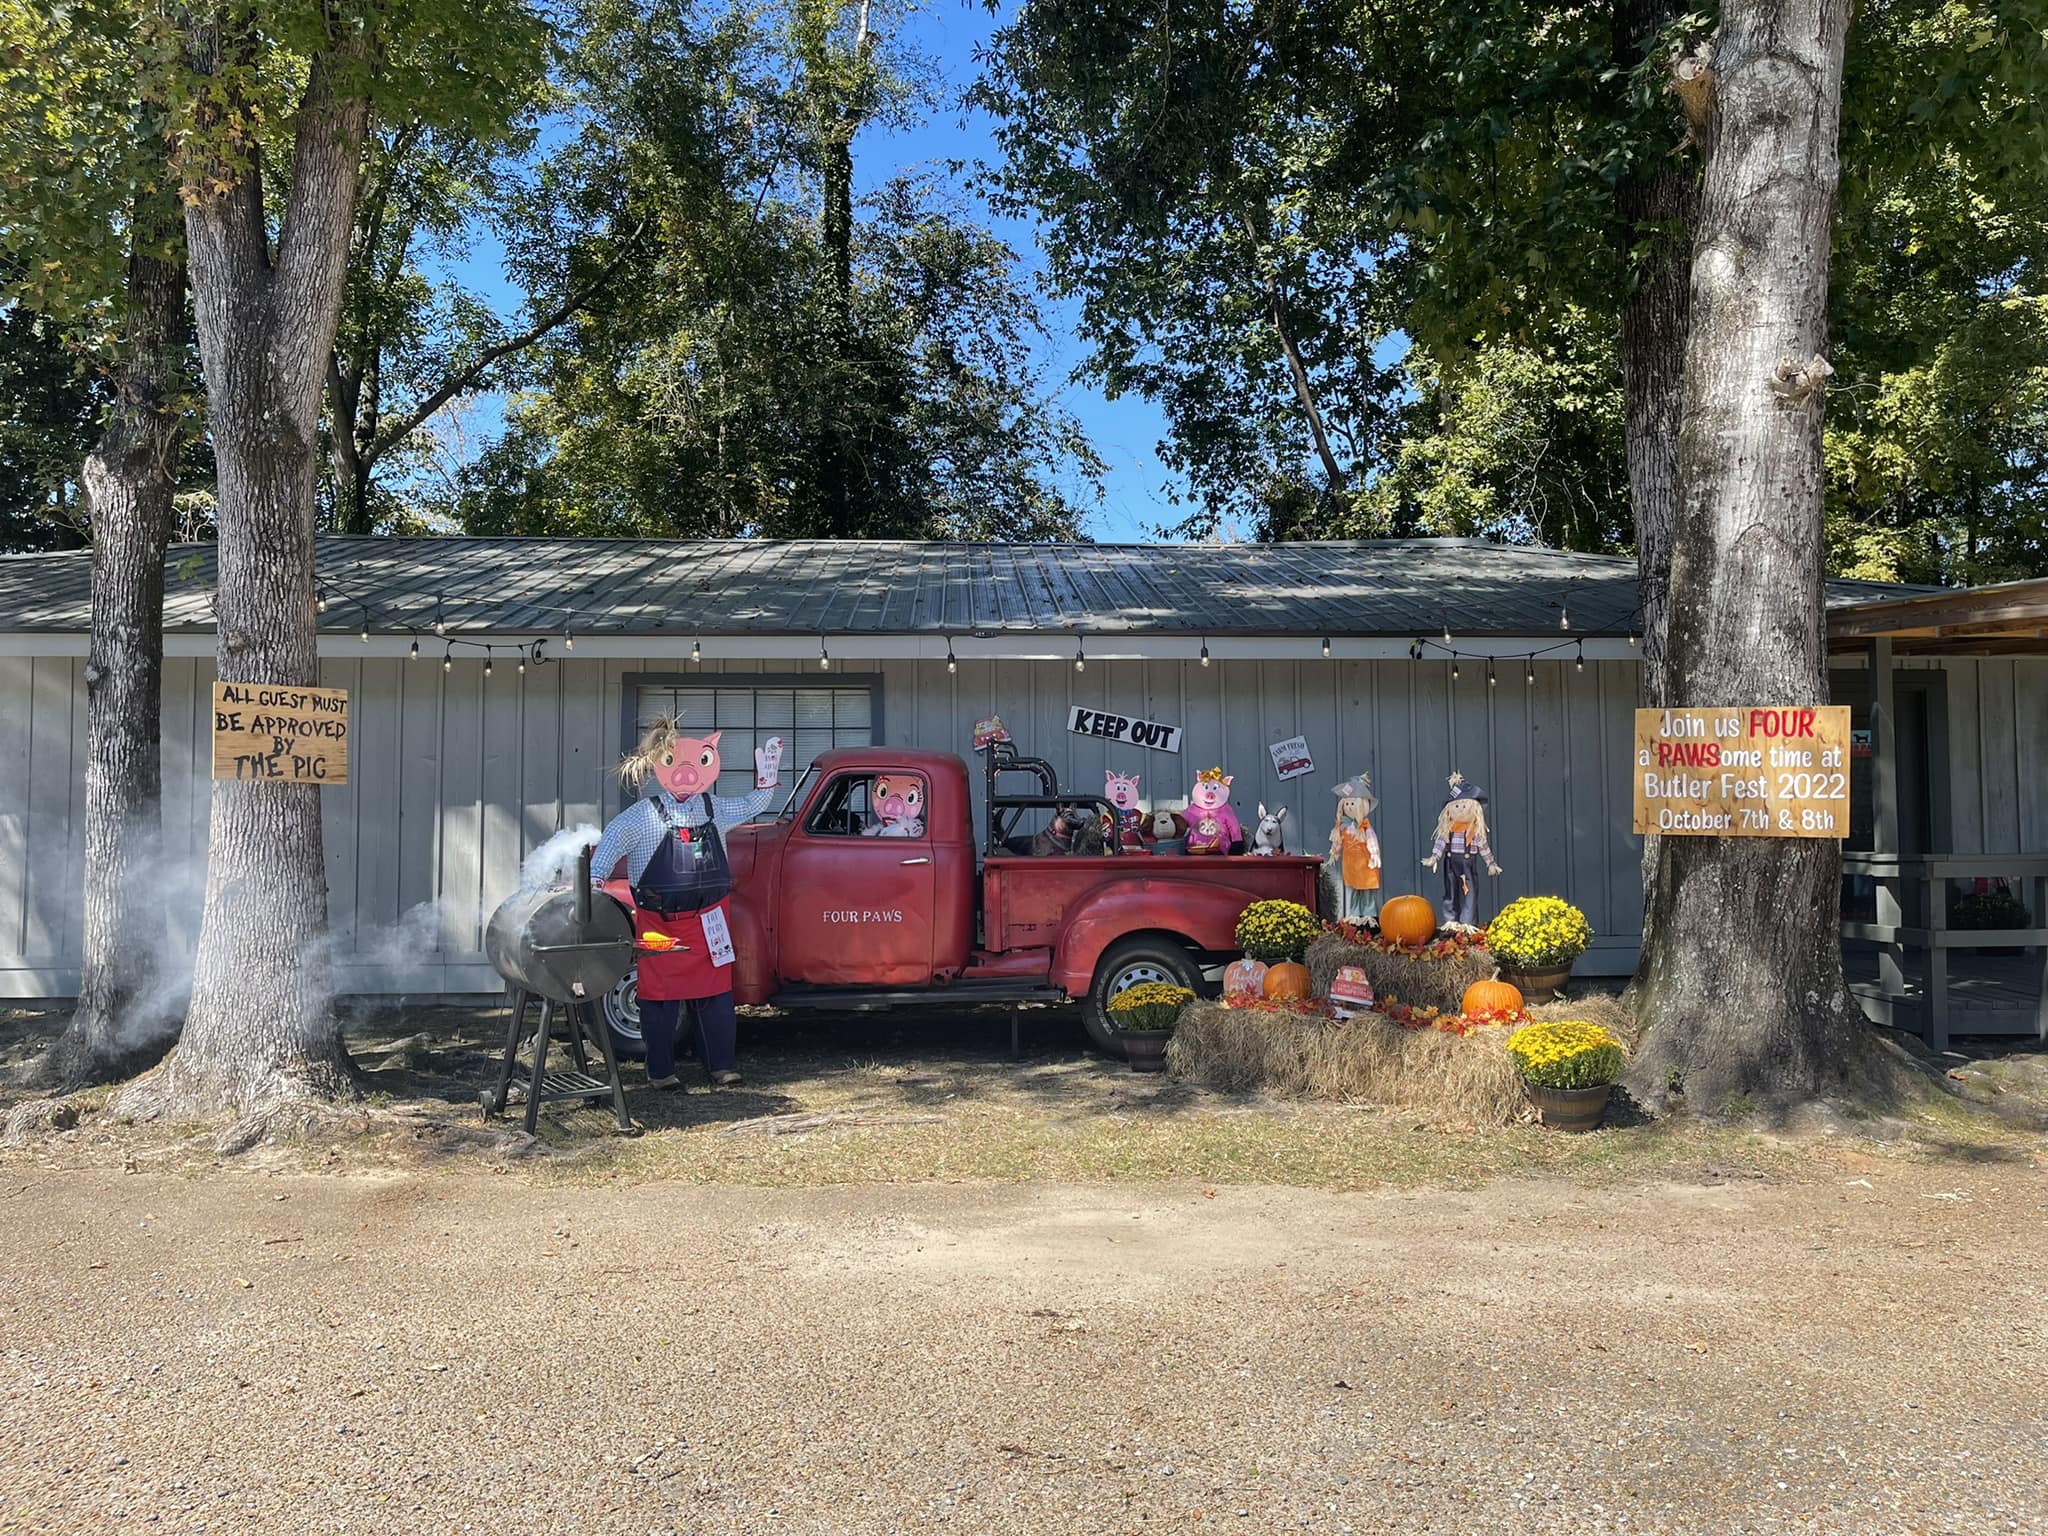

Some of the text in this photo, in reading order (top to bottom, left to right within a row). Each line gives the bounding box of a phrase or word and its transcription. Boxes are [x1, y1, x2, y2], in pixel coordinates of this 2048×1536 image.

[223, 685, 347, 714] ALL GUEST MUST
[215, 711, 346, 741] BE APPROVED
[1074, 709, 1175, 748] KEEP OUT
[1660, 710, 1815, 738] Join us FOUR
[272, 736, 295, 755] BY
[1639, 743, 1842, 768] a PAWSome time at
[233, 752, 326, 779] THE PIG
[1644, 773, 1846, 799] Butler Fest 2022
[1659, 808, 1834, 829] October 7th & 8th
[823, 909, 903, 923] FOUR PAWS
